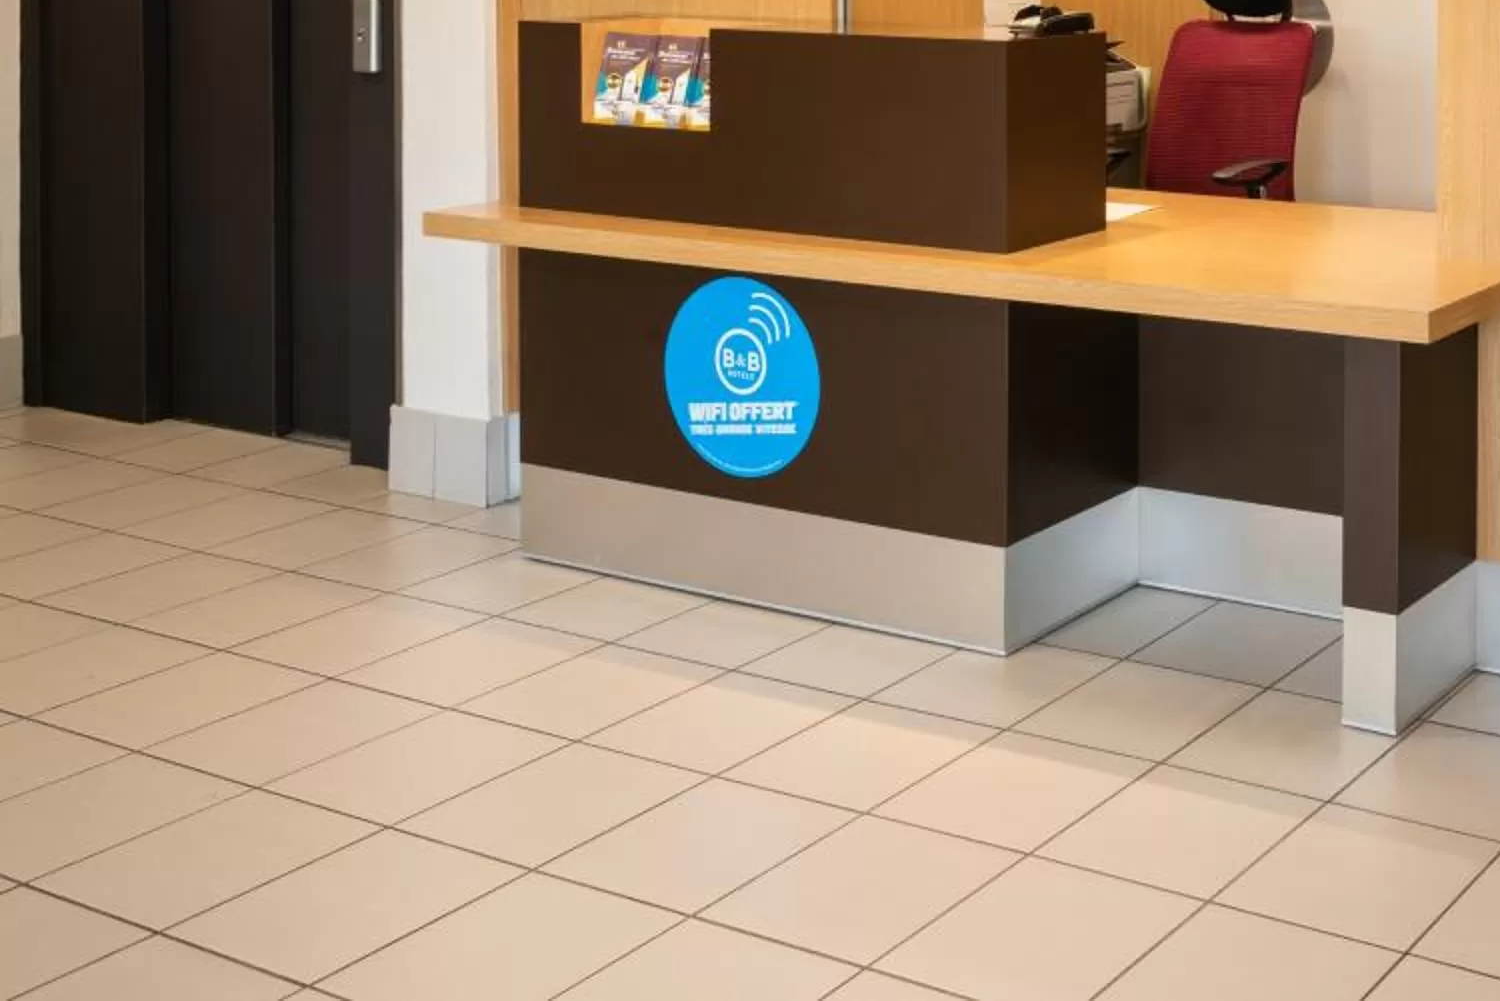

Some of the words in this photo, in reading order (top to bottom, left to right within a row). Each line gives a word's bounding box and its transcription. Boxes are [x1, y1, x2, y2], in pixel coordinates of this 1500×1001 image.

[723, 348, 761, 372] B&B
[688, 402, 727, 422] WIFI
[729, 400, 799, 421] OFFERT
